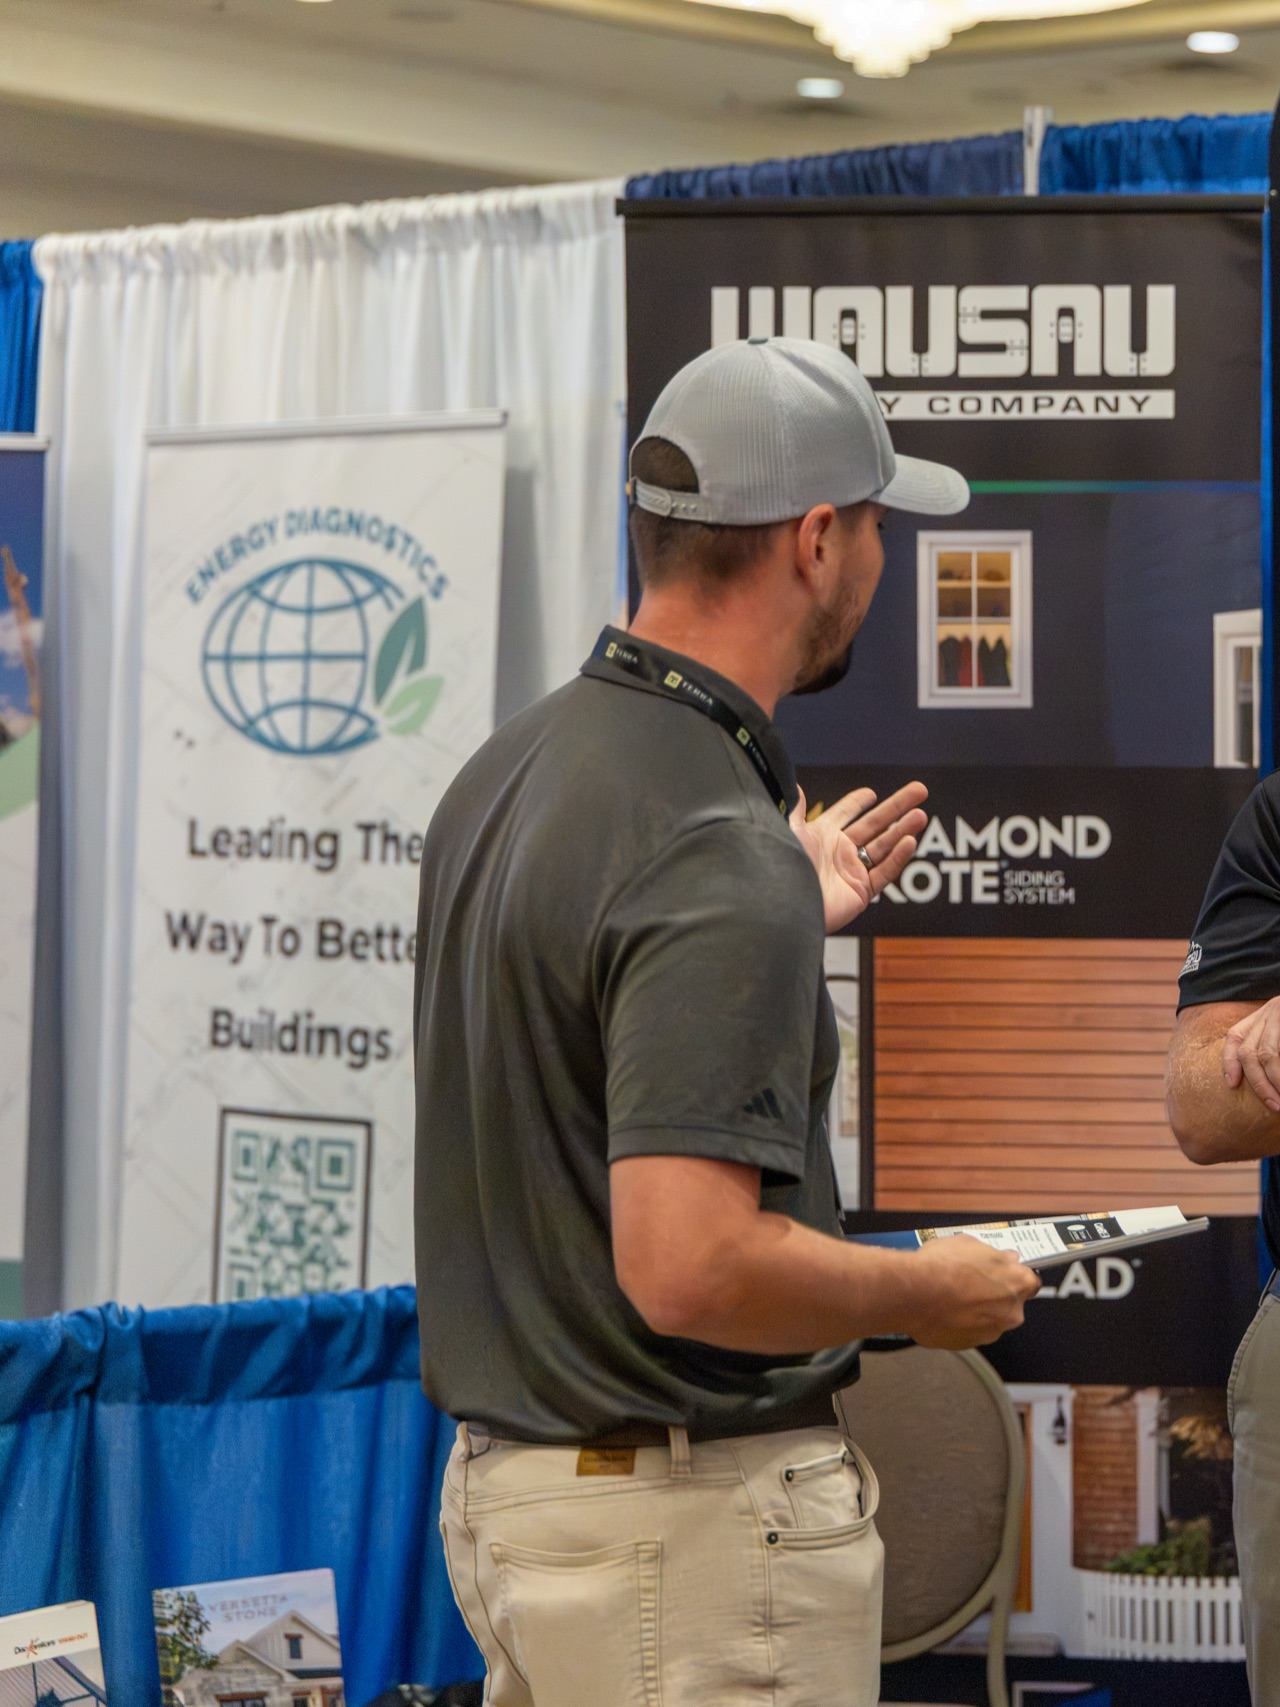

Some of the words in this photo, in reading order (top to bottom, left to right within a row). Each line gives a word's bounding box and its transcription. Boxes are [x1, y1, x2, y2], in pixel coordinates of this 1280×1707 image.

[927, 395, 1152, 415] COMPANY
[183, 515, 280, 604] ENERGY
[284, 505, 451, 602] DIAGNOSTICS
[682, 680, 714, 706] TERRA
[186, 815, 341, 874] Leading
[354, 817, 425, 865] The
[910, 814, 1112, 860] AMOND
[1003, 870, 1066, 888] SIDING
[1003, 887, 1076, 905] SYSTEM
[165, 908, 251, 967] Way
[260, 912, 302, 958] To
[316, 915, 417, 964] Bette
[210, 1004, 393, 1071] Buildings
[207, 1594, 290, 1613] VERSETTA
[223, 1606, 278, 1622] STONE
